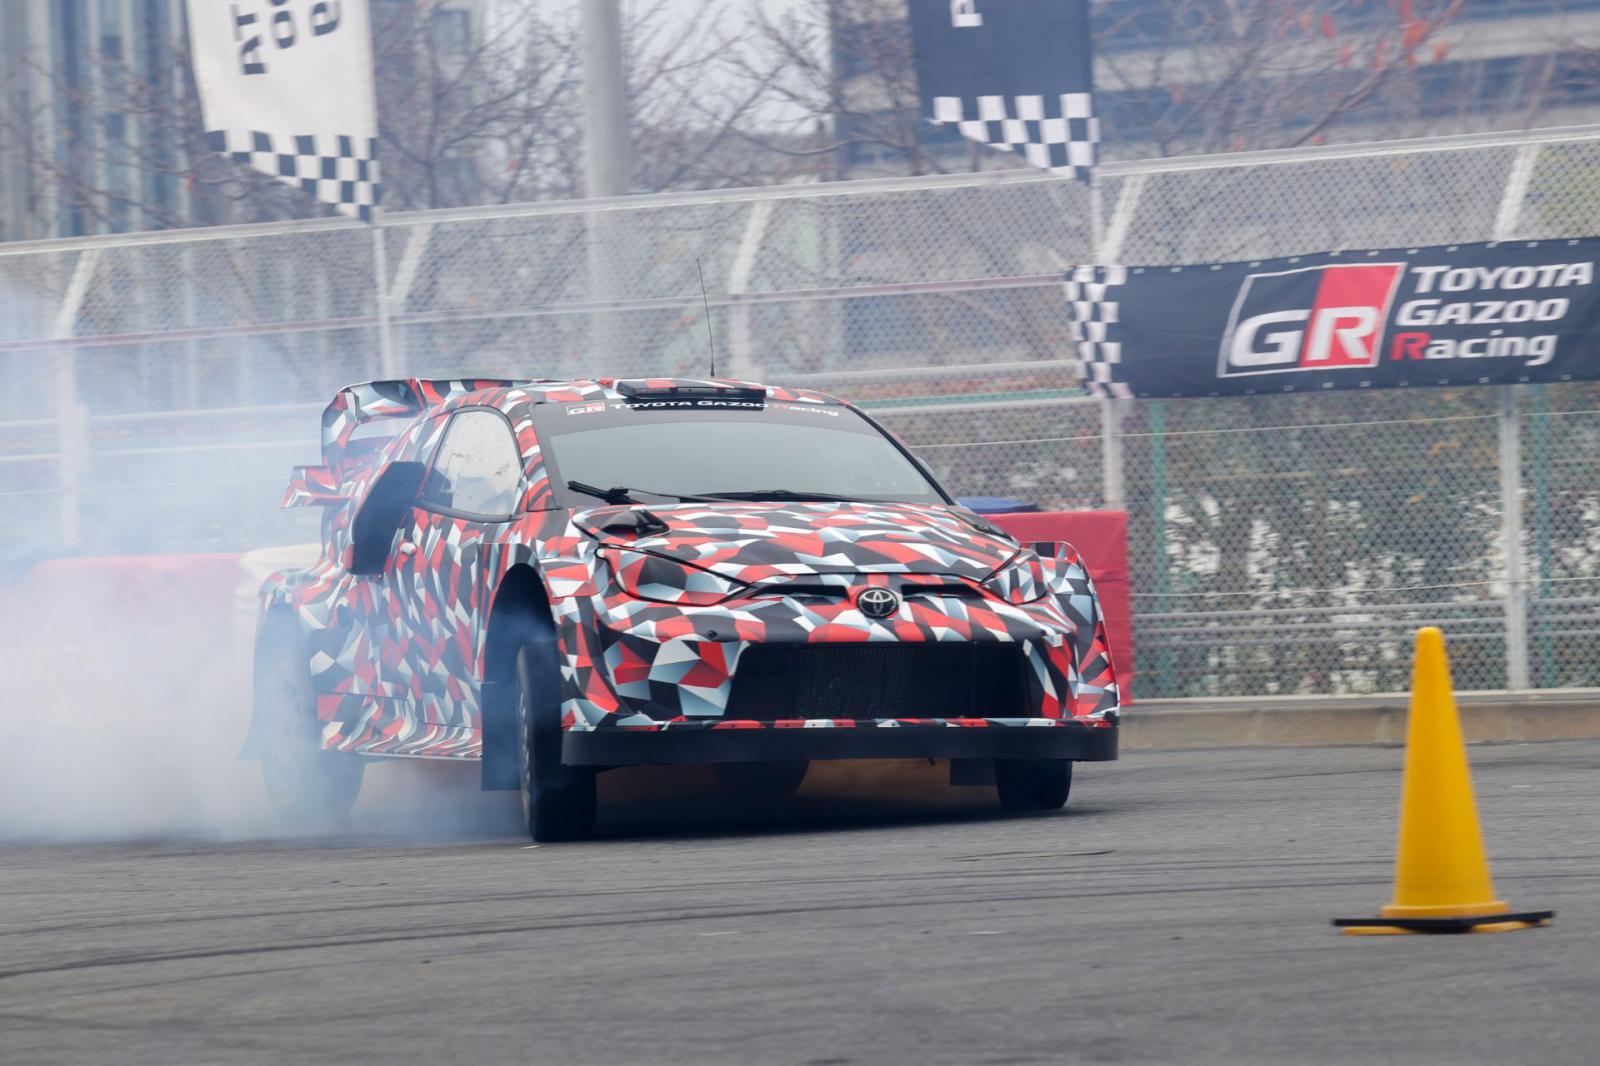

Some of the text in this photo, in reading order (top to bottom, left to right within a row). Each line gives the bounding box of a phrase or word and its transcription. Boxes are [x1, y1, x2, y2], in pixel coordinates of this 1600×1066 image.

[1411, 262, 1594, 293] TOYOTA
[1395, 298, 1570, 326] GAZOO
[1229, 305, 1381, 367] GR
[1390, 329, 1559, 366] Racing
[610, 400, 693, 410] TOYOTA
